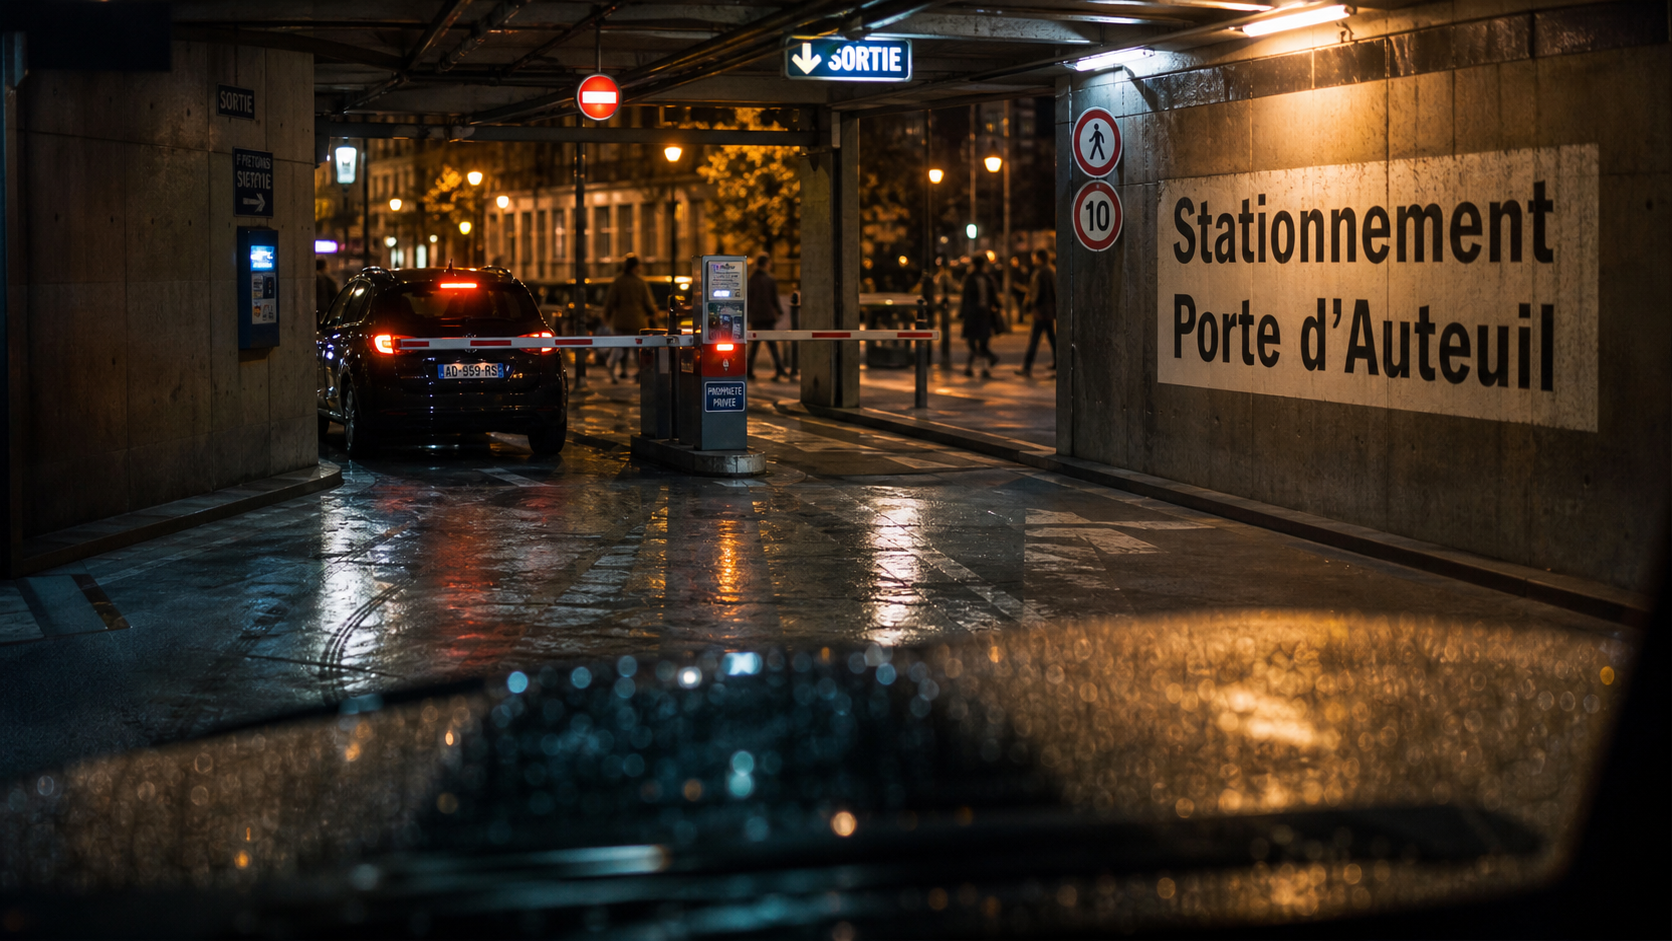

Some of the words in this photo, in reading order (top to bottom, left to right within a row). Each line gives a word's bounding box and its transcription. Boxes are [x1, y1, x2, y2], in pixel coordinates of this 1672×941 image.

[828, 45, 902, 72] SORTIE
[220, 90, 253, 113] SORTIE
[1086, 200, 1110, 231] 10
[1173, 180, 1554, 264] Stationnement
[1173, 294, 1281, 368] Porte
[1301, 298, 1554, 392] d’Auteuil
